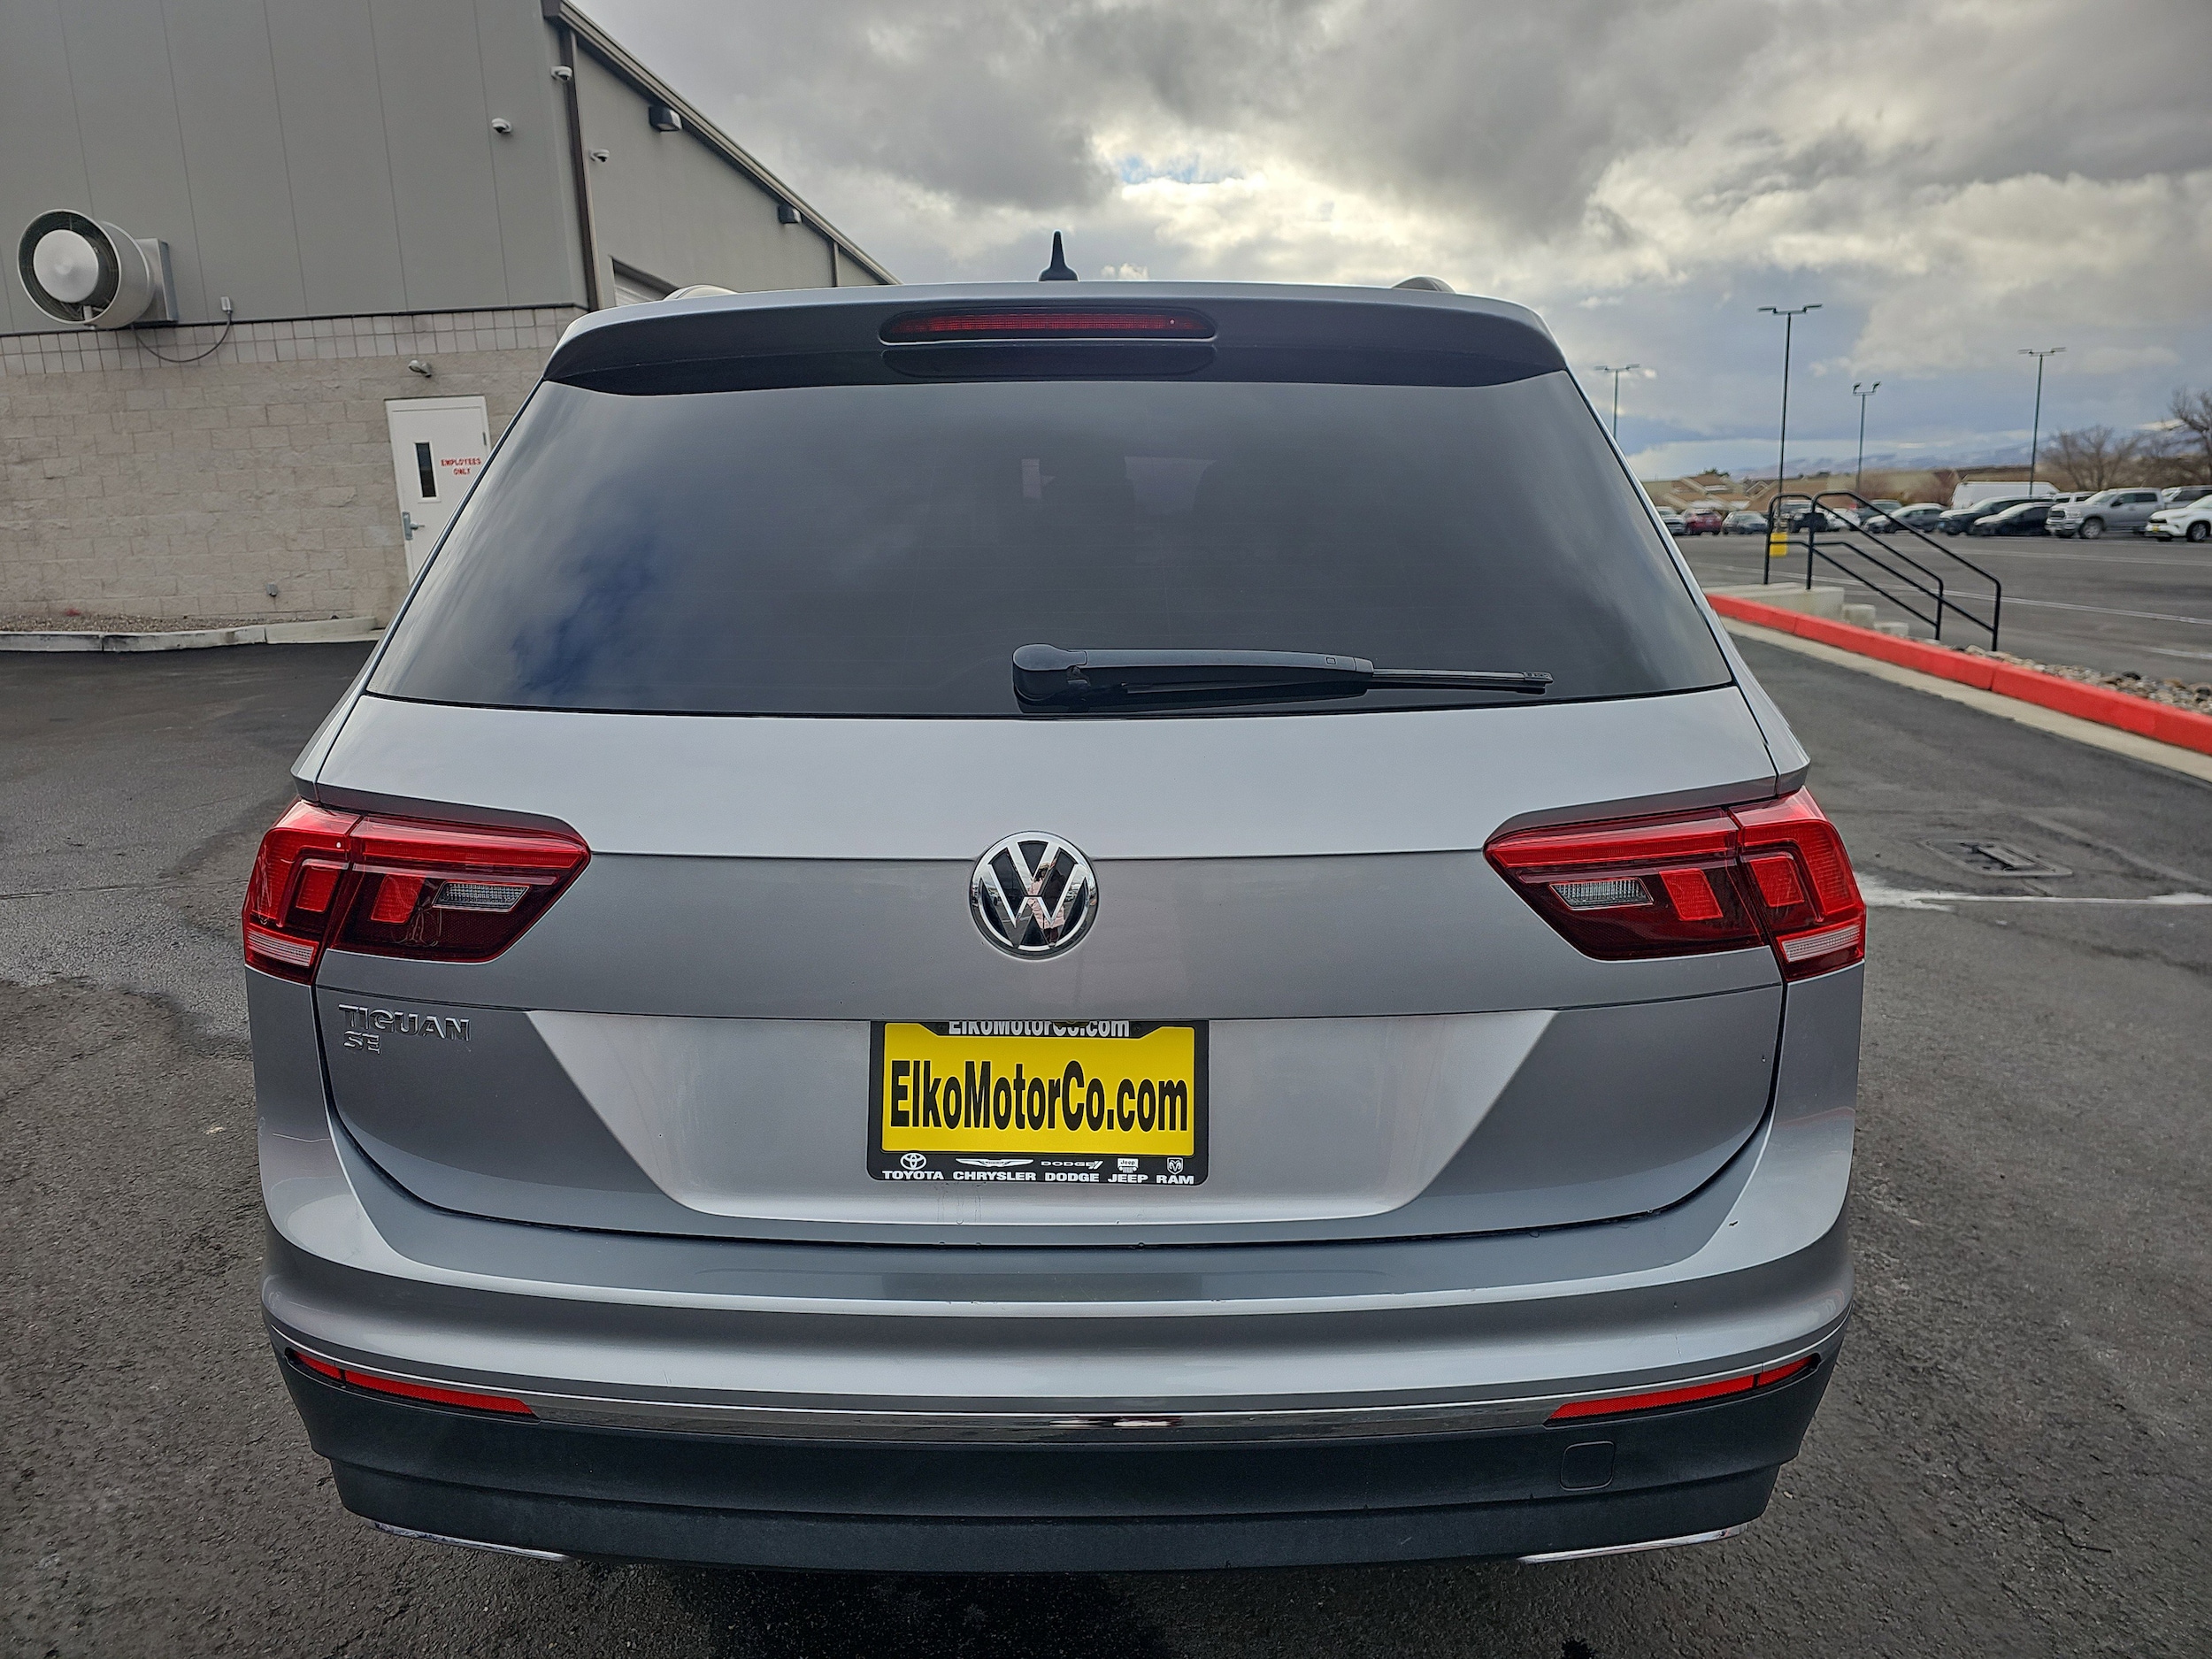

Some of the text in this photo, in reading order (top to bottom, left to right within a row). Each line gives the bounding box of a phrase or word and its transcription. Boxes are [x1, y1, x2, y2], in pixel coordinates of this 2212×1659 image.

[441, 457, 481, 466] EMPLOYEES
[338, 1003, 471, 1042] TIGUAN
[343, 1029, 381, 1055] SE
[890, 1059, 1188, 1132] ElkoMotorCo.com
[882, 1171, 1194, 1185] TOYOTA CHRYSLER DODGE JEEP RAM
